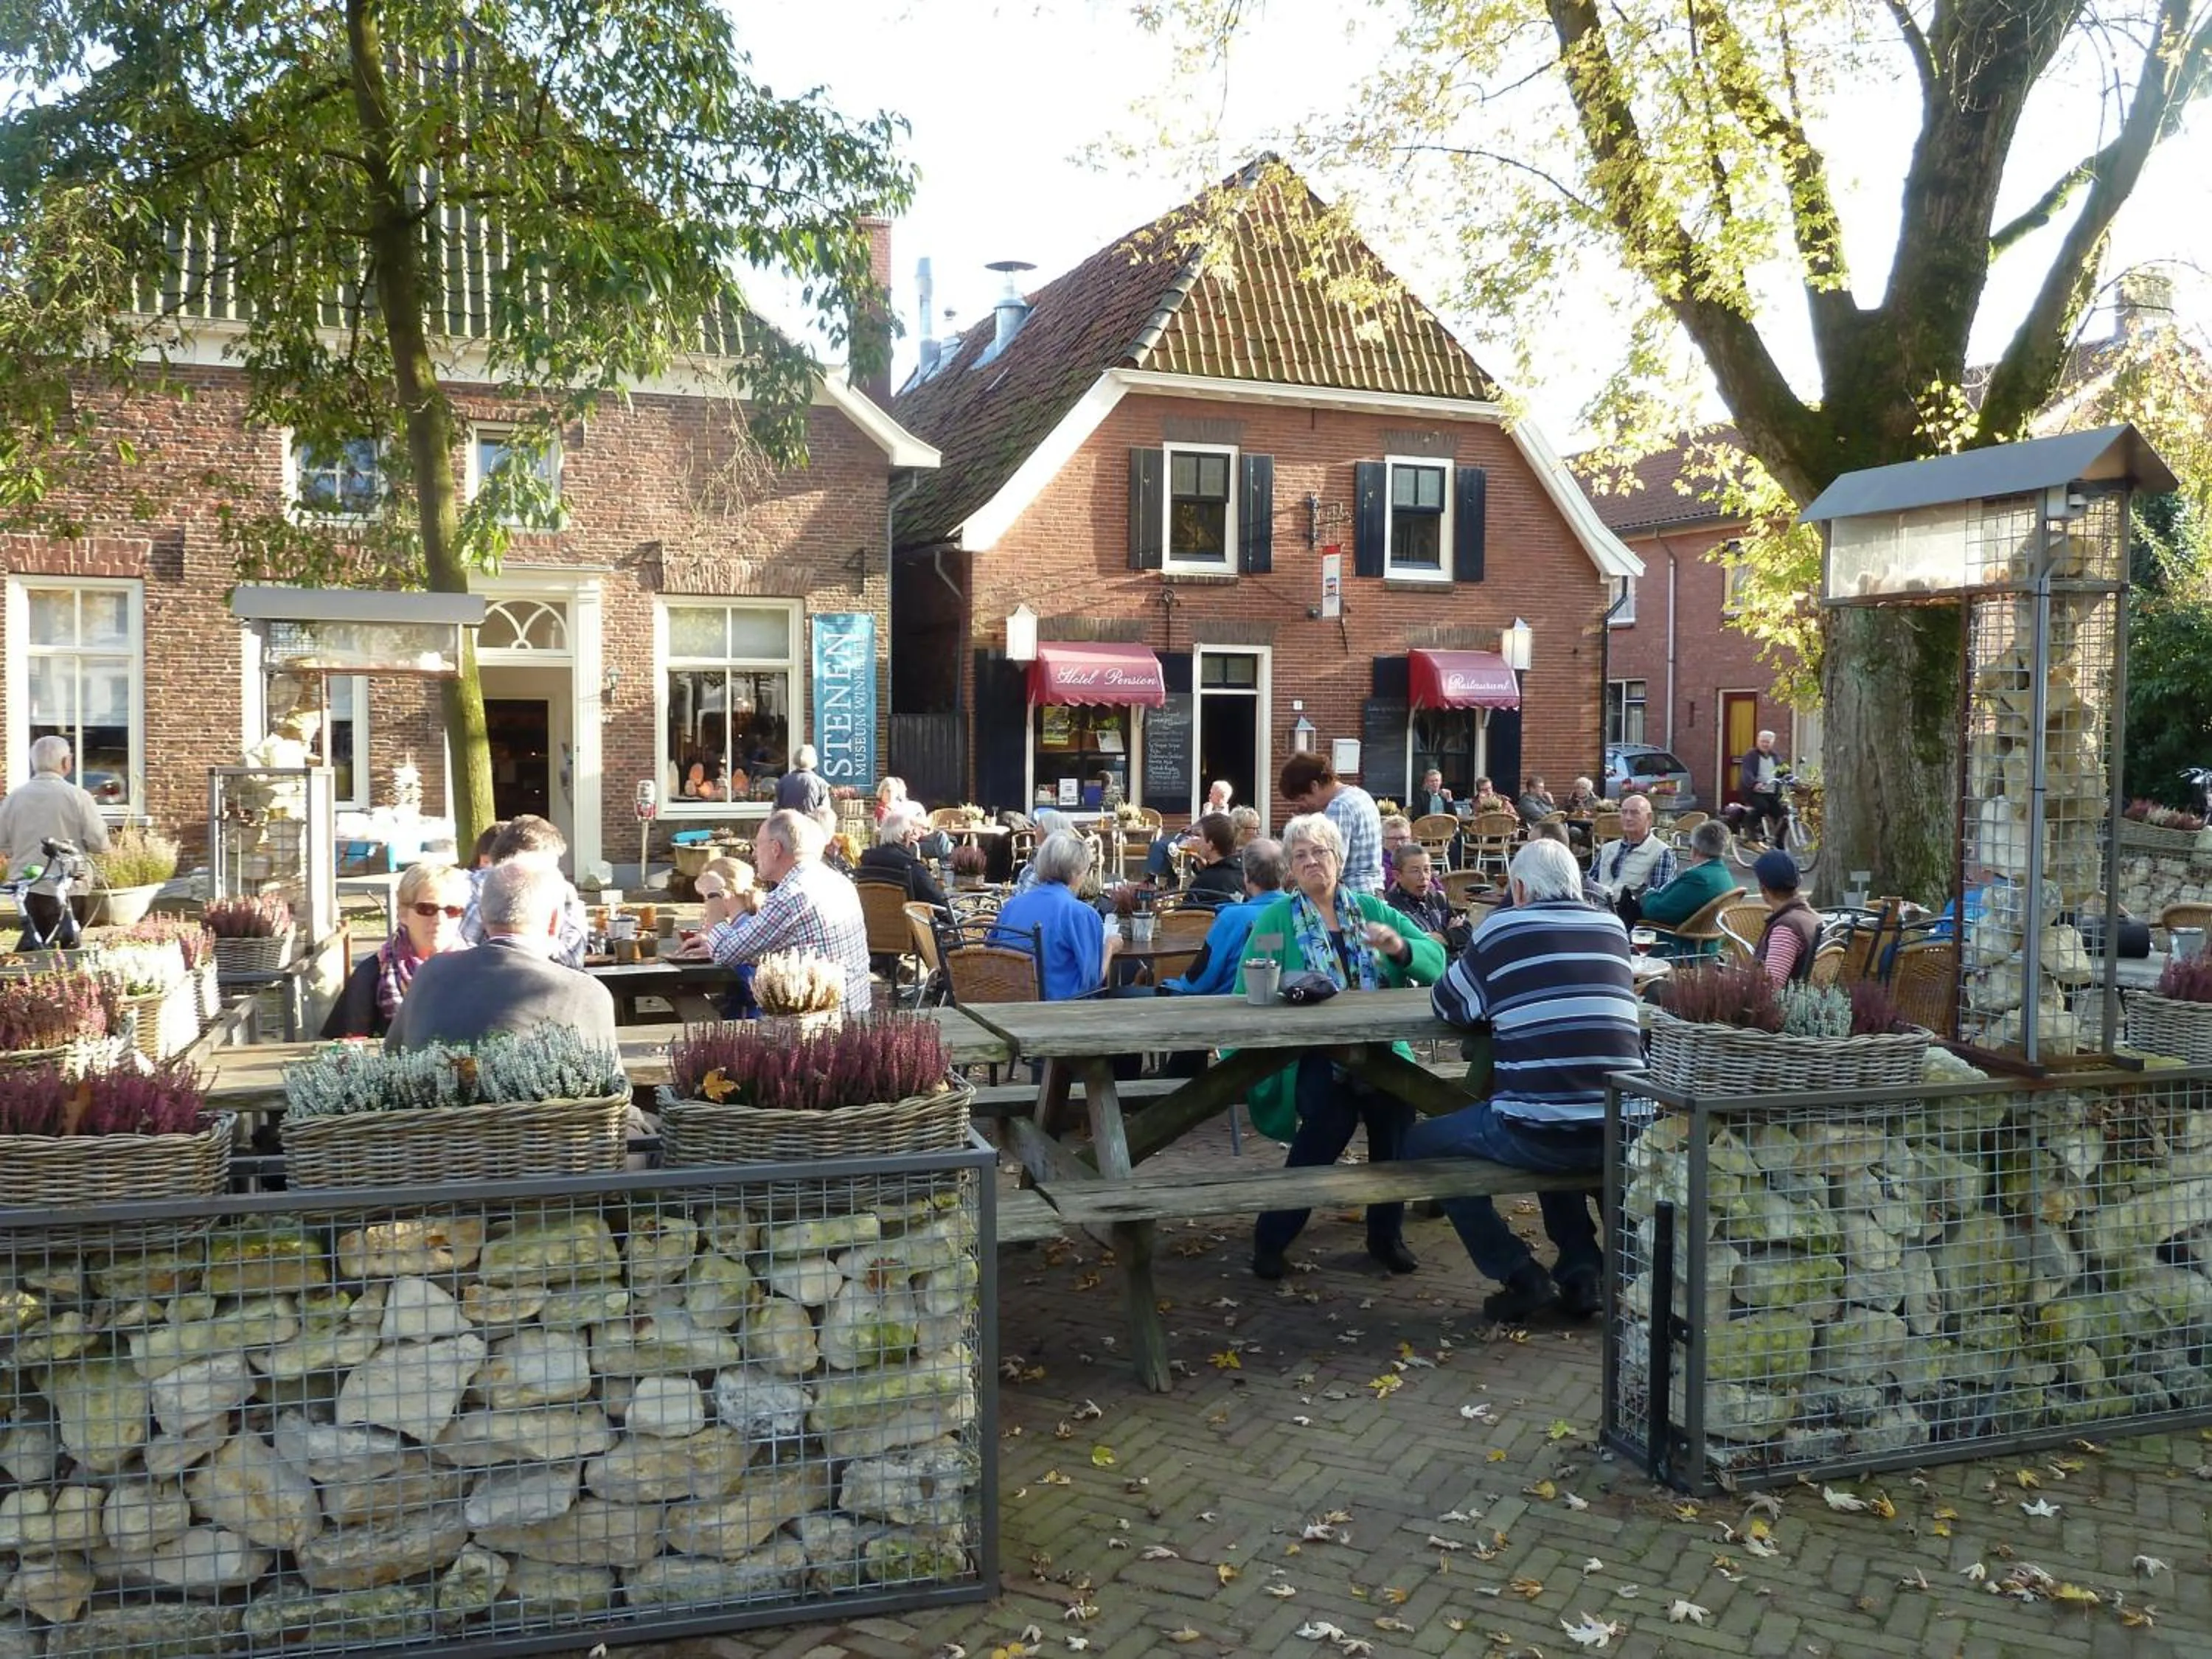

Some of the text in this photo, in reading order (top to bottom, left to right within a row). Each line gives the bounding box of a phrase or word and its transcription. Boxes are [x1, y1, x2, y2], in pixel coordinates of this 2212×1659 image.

[1056, 666, 1158, 685] Hotel Pension
[1449, 673, 1510, 691] Restaurant
[824, 631, 852, 777] STENEN
[855, 714, 866, 776] MUSEUM
